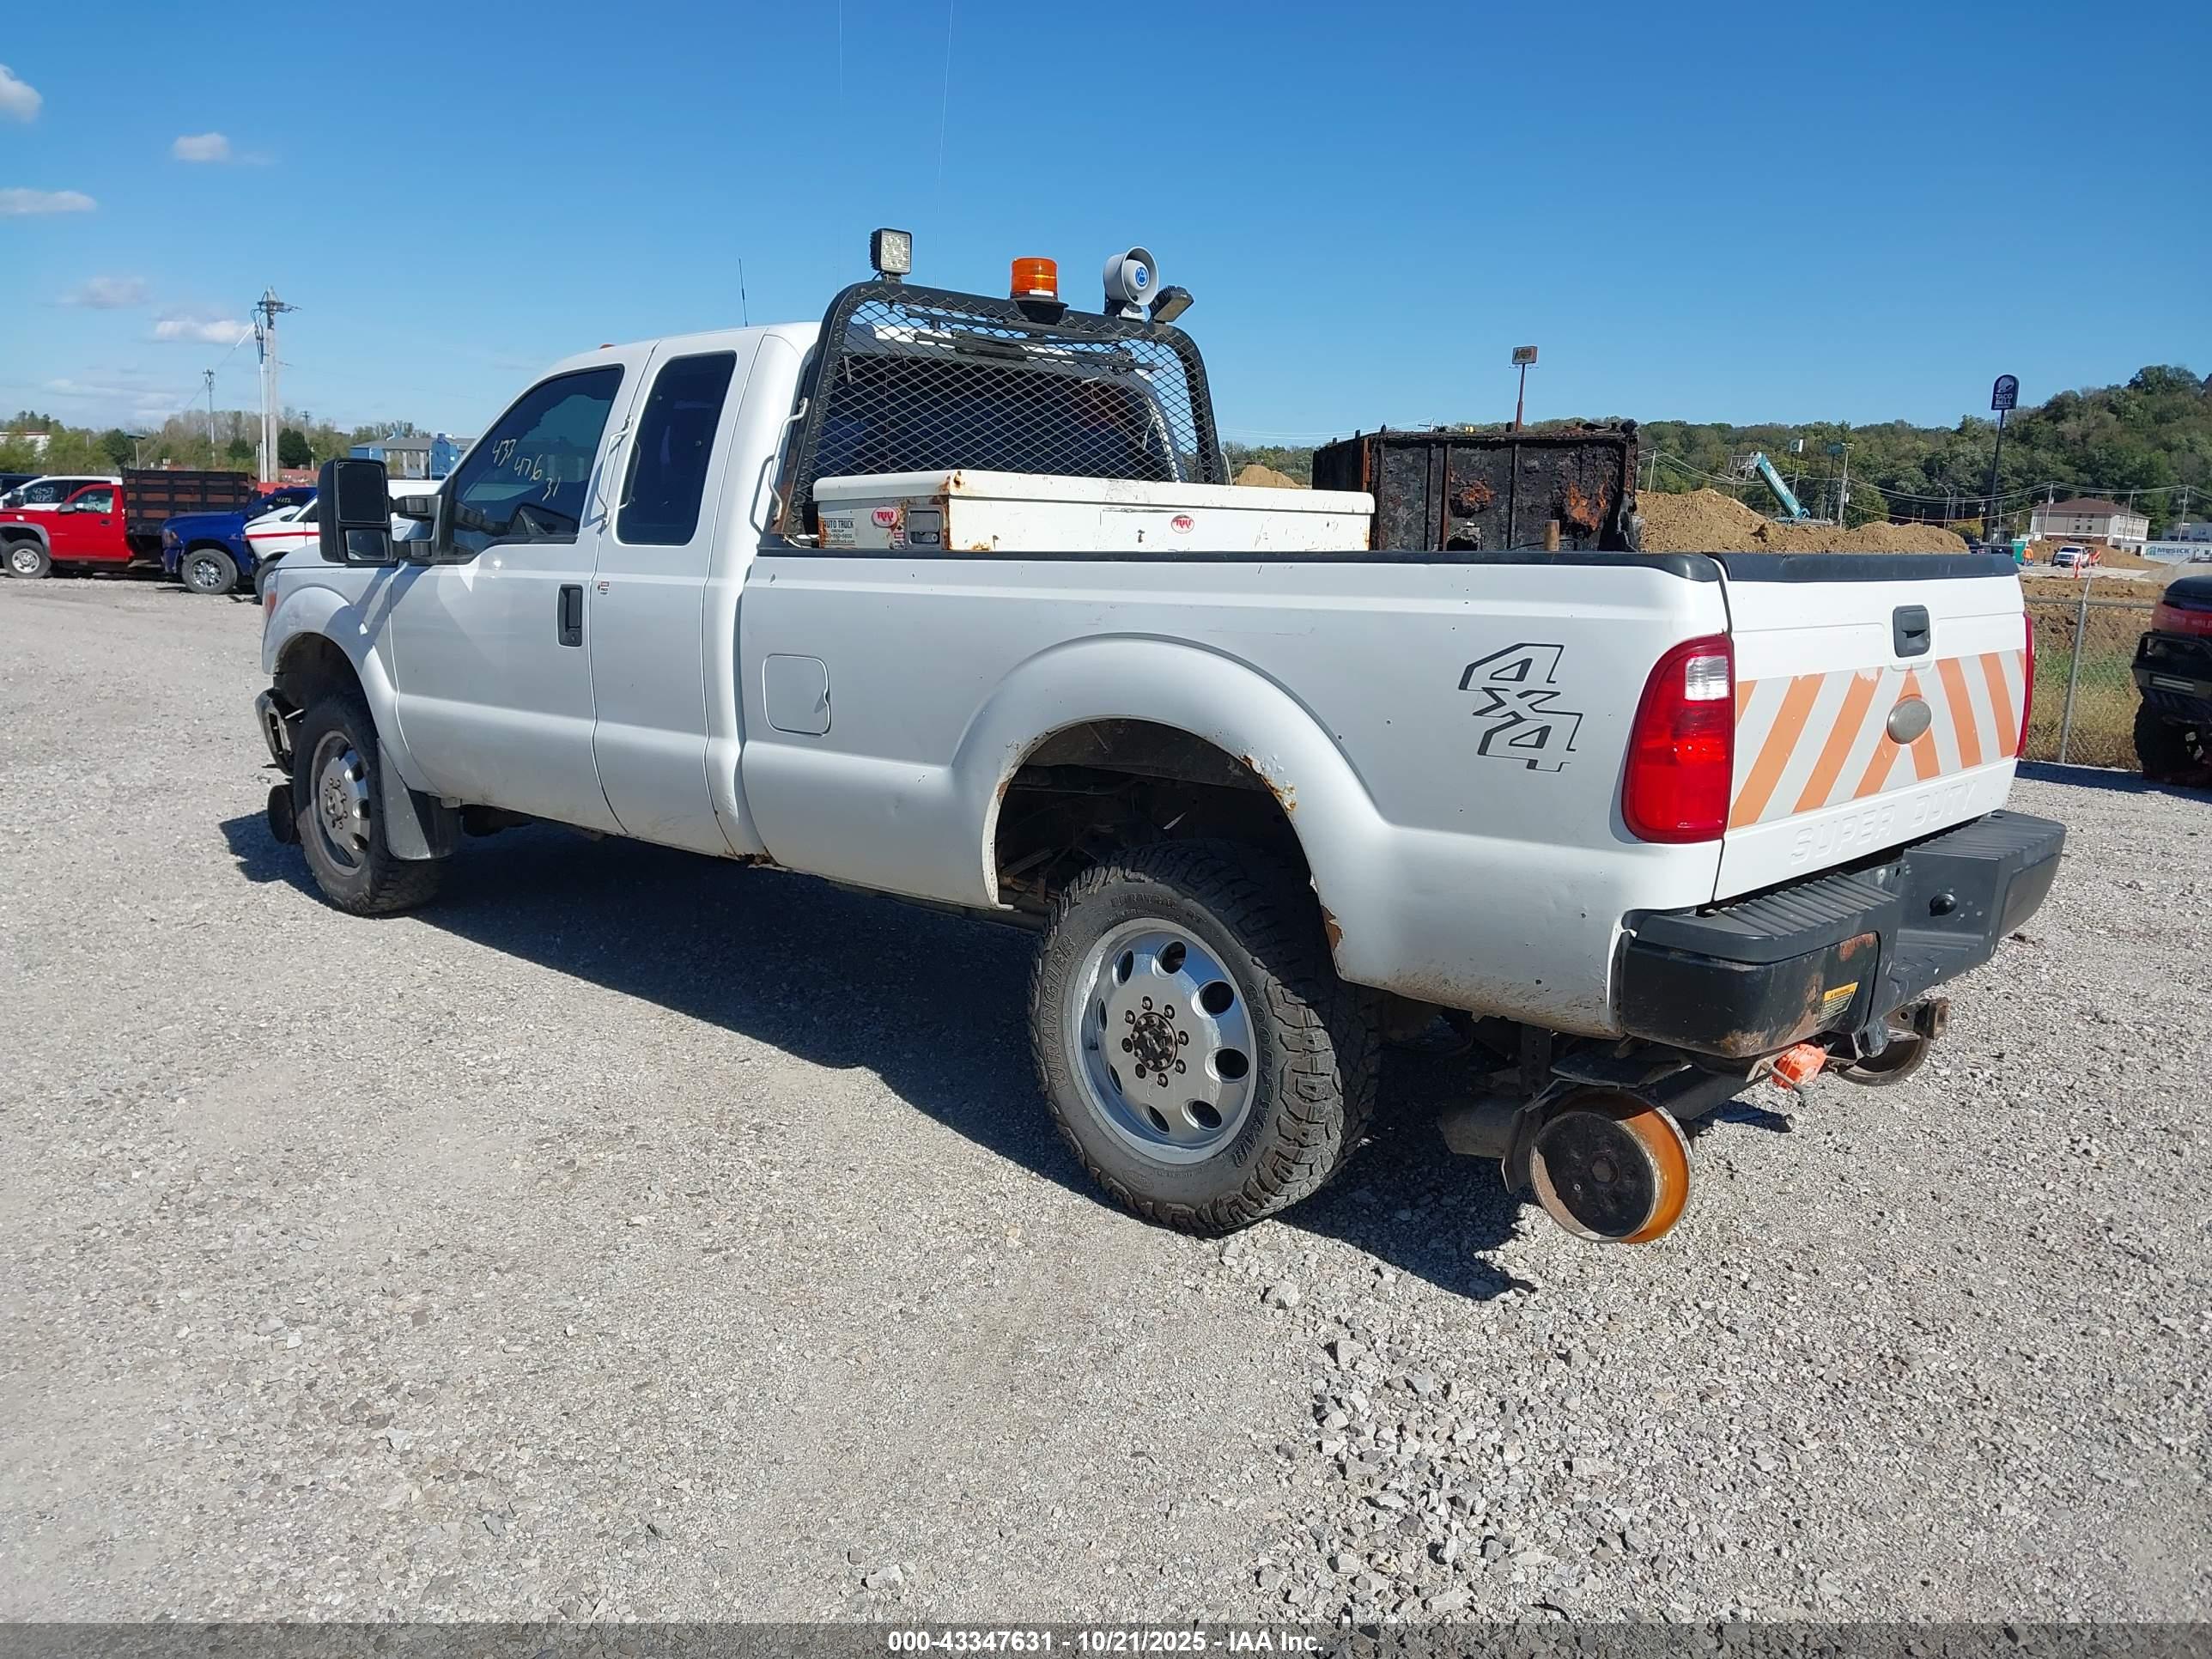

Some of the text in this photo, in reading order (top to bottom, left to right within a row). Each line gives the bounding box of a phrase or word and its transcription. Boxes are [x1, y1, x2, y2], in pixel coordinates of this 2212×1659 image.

[514, 453, 543, 481] 476
[542, 476, 561, 501] 31
[823, 520, 854, 529] AUTO TRUCK
[1790, 779, 1978, 866] SUPER DUTY
[1042, 934, 1075, 1091] WRANGLER
[1233, 981, 1276, 1168] GOODYEAR
